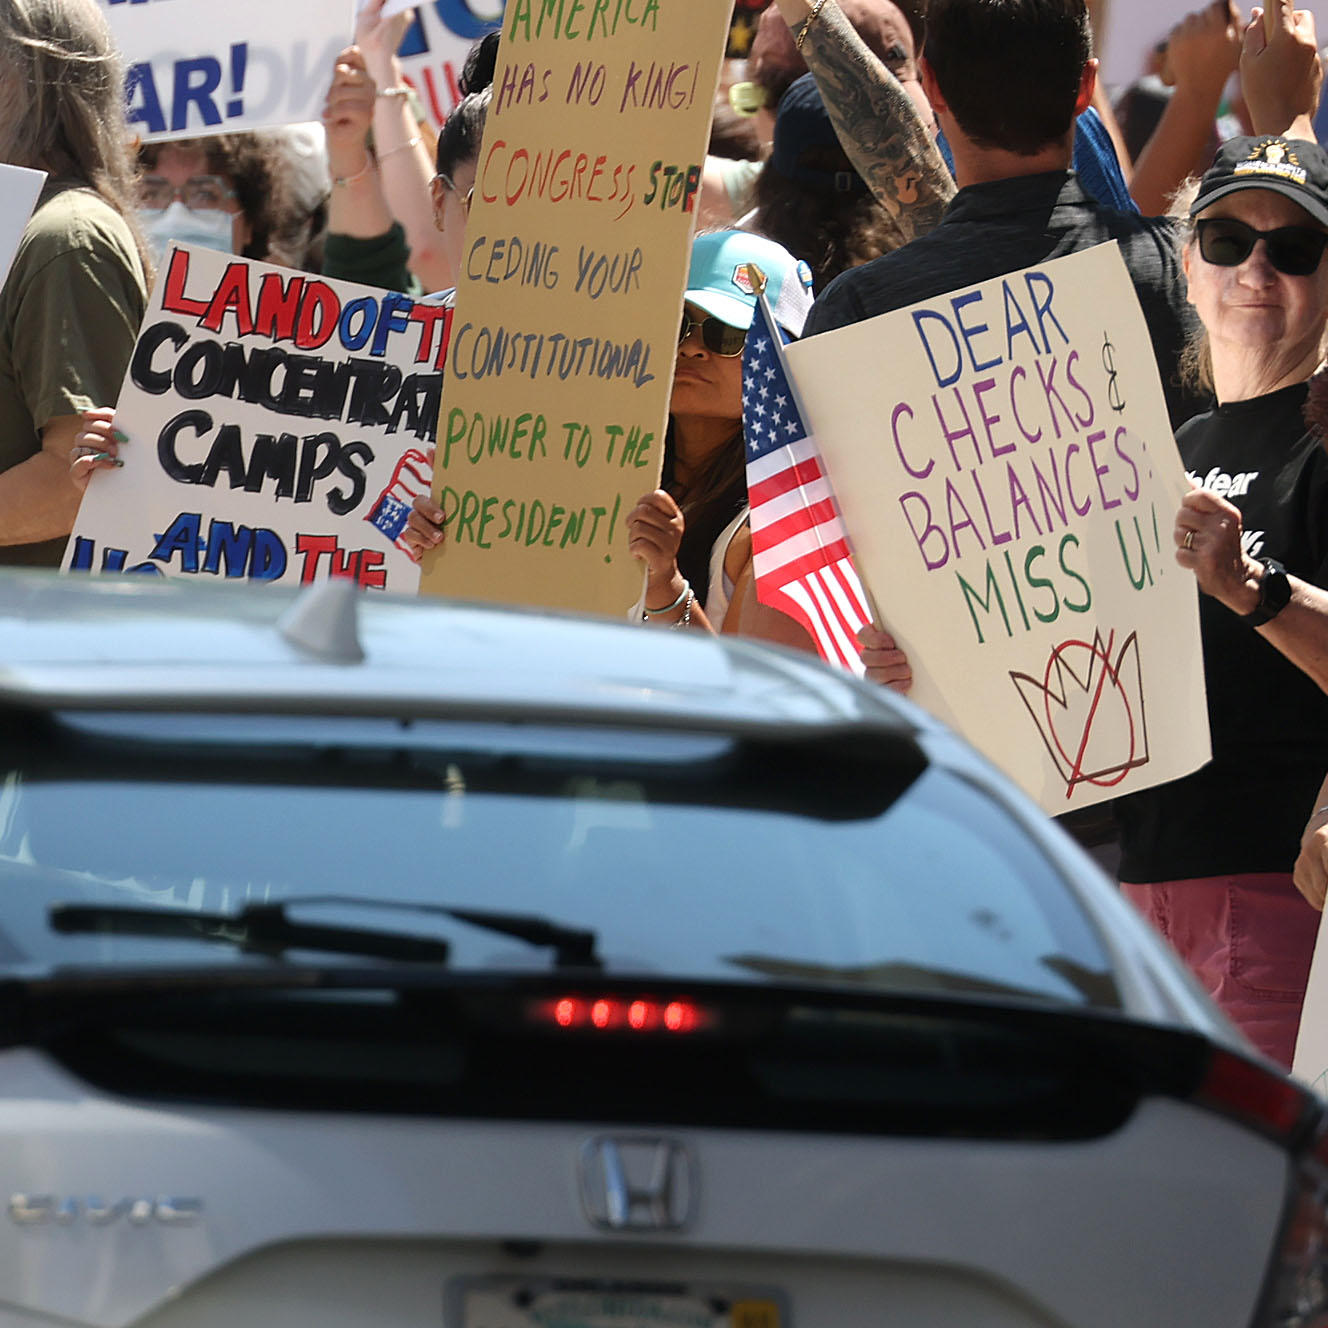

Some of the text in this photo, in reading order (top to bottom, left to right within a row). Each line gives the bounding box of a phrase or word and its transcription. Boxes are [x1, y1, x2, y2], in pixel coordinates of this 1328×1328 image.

[125, 42, 248, 135] AR!
[567, 63, 603, 107] NO
[619, 61, 699, 110] KING!
[480, 139, 702, 221] CONGRESS, STOP
[163, 248, 341, 349] LAND
[340, 293, 410, 358] OF
[468, 237, 642, 299] CEDING YOUR
[454, 323, 655, 387] CONSTITUTIONAL
[912, 273, 1069, 388] DEAR
[445, 407, 652, 468] POWER TO THE
[891, 351, 1094, 479] CHECKS
[158, 411, 374, 514] CAMPS
[152, 511, 287, 585] AND
[296, 534, 387, 592] THE
[441, 488, 621, 564] PRESIDENT!
[955, 503, 1164, 643] MISS U!
